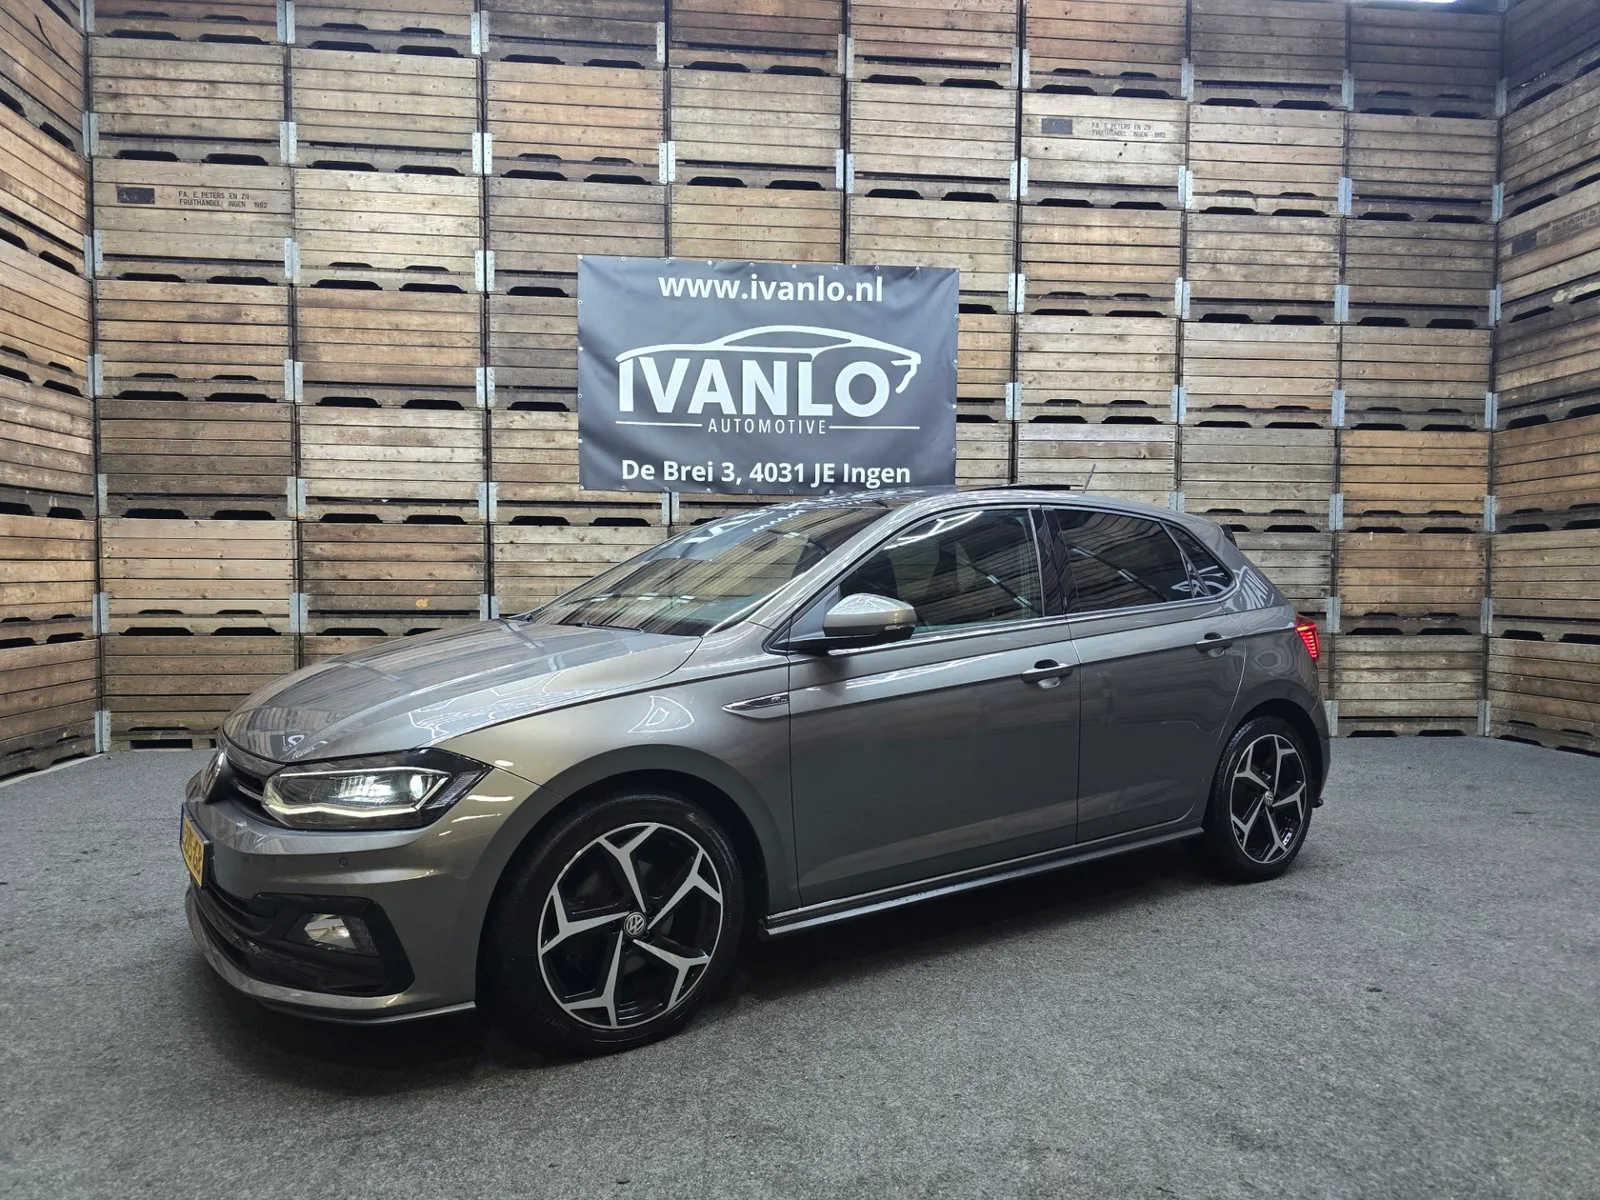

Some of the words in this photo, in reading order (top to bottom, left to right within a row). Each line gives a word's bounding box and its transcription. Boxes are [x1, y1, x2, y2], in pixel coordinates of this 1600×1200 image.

[180, 198, 221, 207] FRUITHANDEL
[658, 273, 883, 302] www.ivanlo.nl
[618, 356, 890, 418] IVANLO
[707, 417, 827, 434] AUTOMOTIVE
[621, 459, 656, 482] De
[663, 460, 714, 483] Brei
[721, 462, 743, 486] 3,
[749, 462, 804, 483] 4031
[810, 463, 835, 488] JE
[843, 463, 911, 489] Ingen
